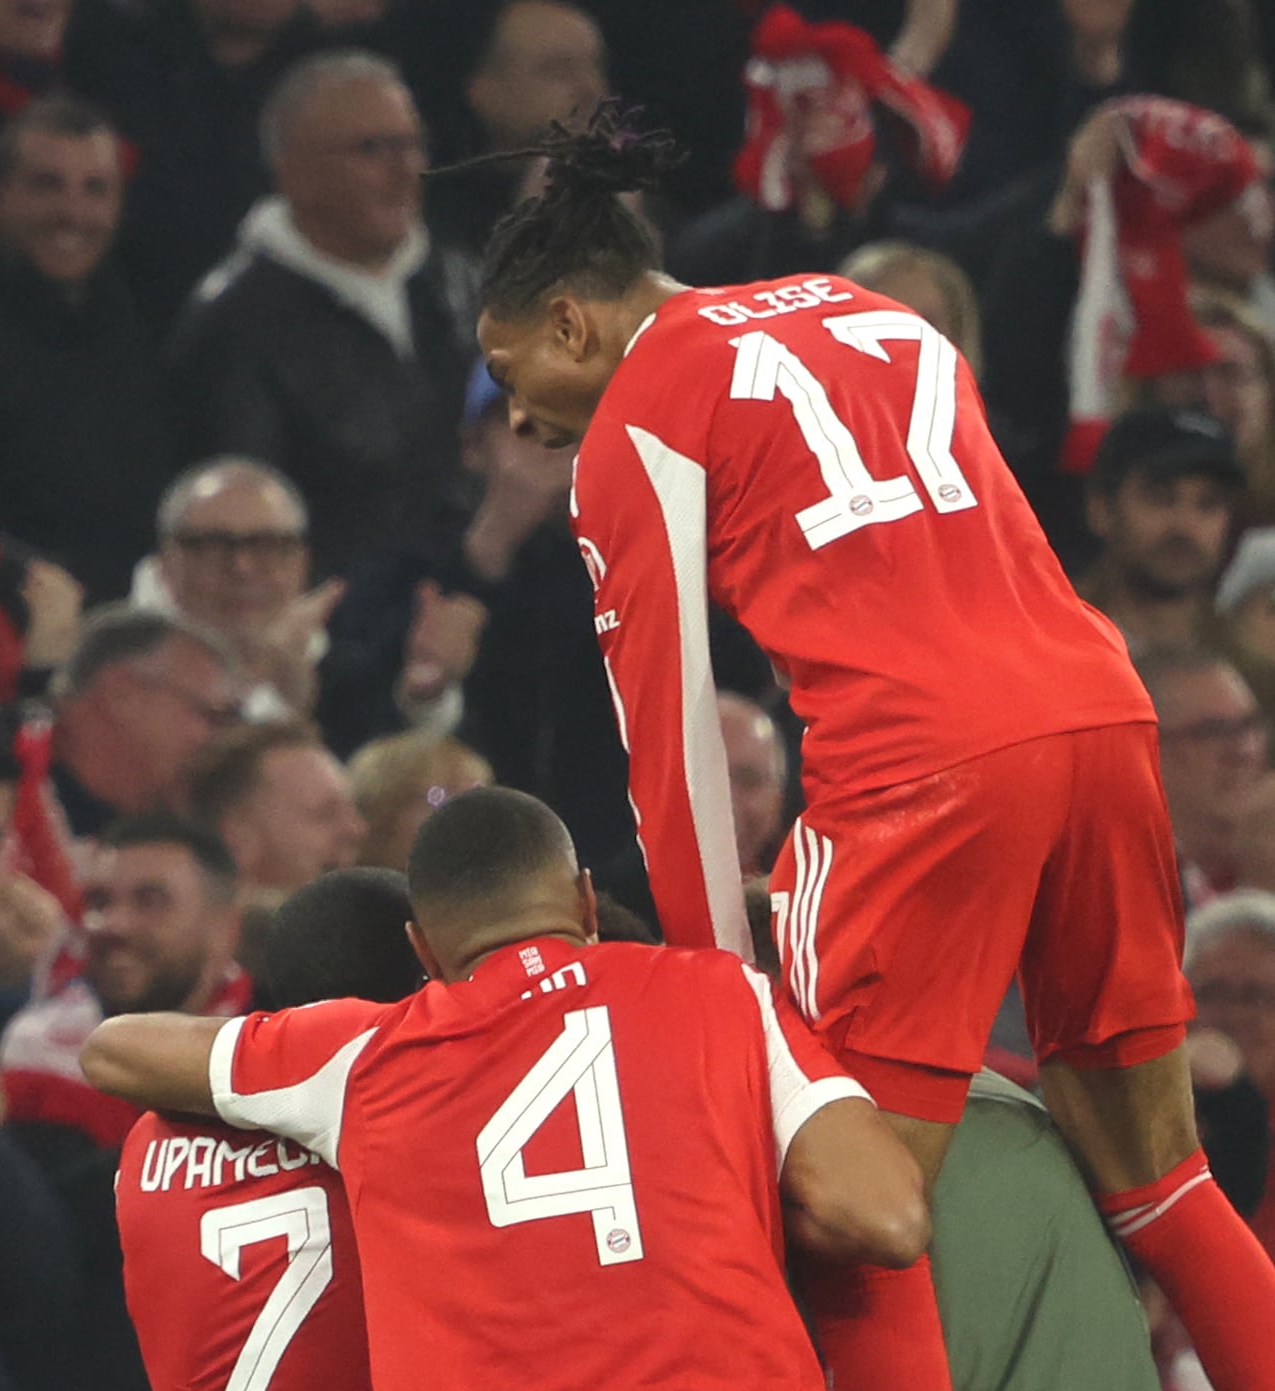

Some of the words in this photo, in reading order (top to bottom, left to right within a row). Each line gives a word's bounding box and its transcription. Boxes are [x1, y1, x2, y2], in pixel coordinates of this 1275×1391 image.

[697, 278, 854, 326] OLISE
[727, 310, 980, 552] 17
[140, 1135, 322, 1192] UPAMEC
[476, 1004, 645, 1267] 4
